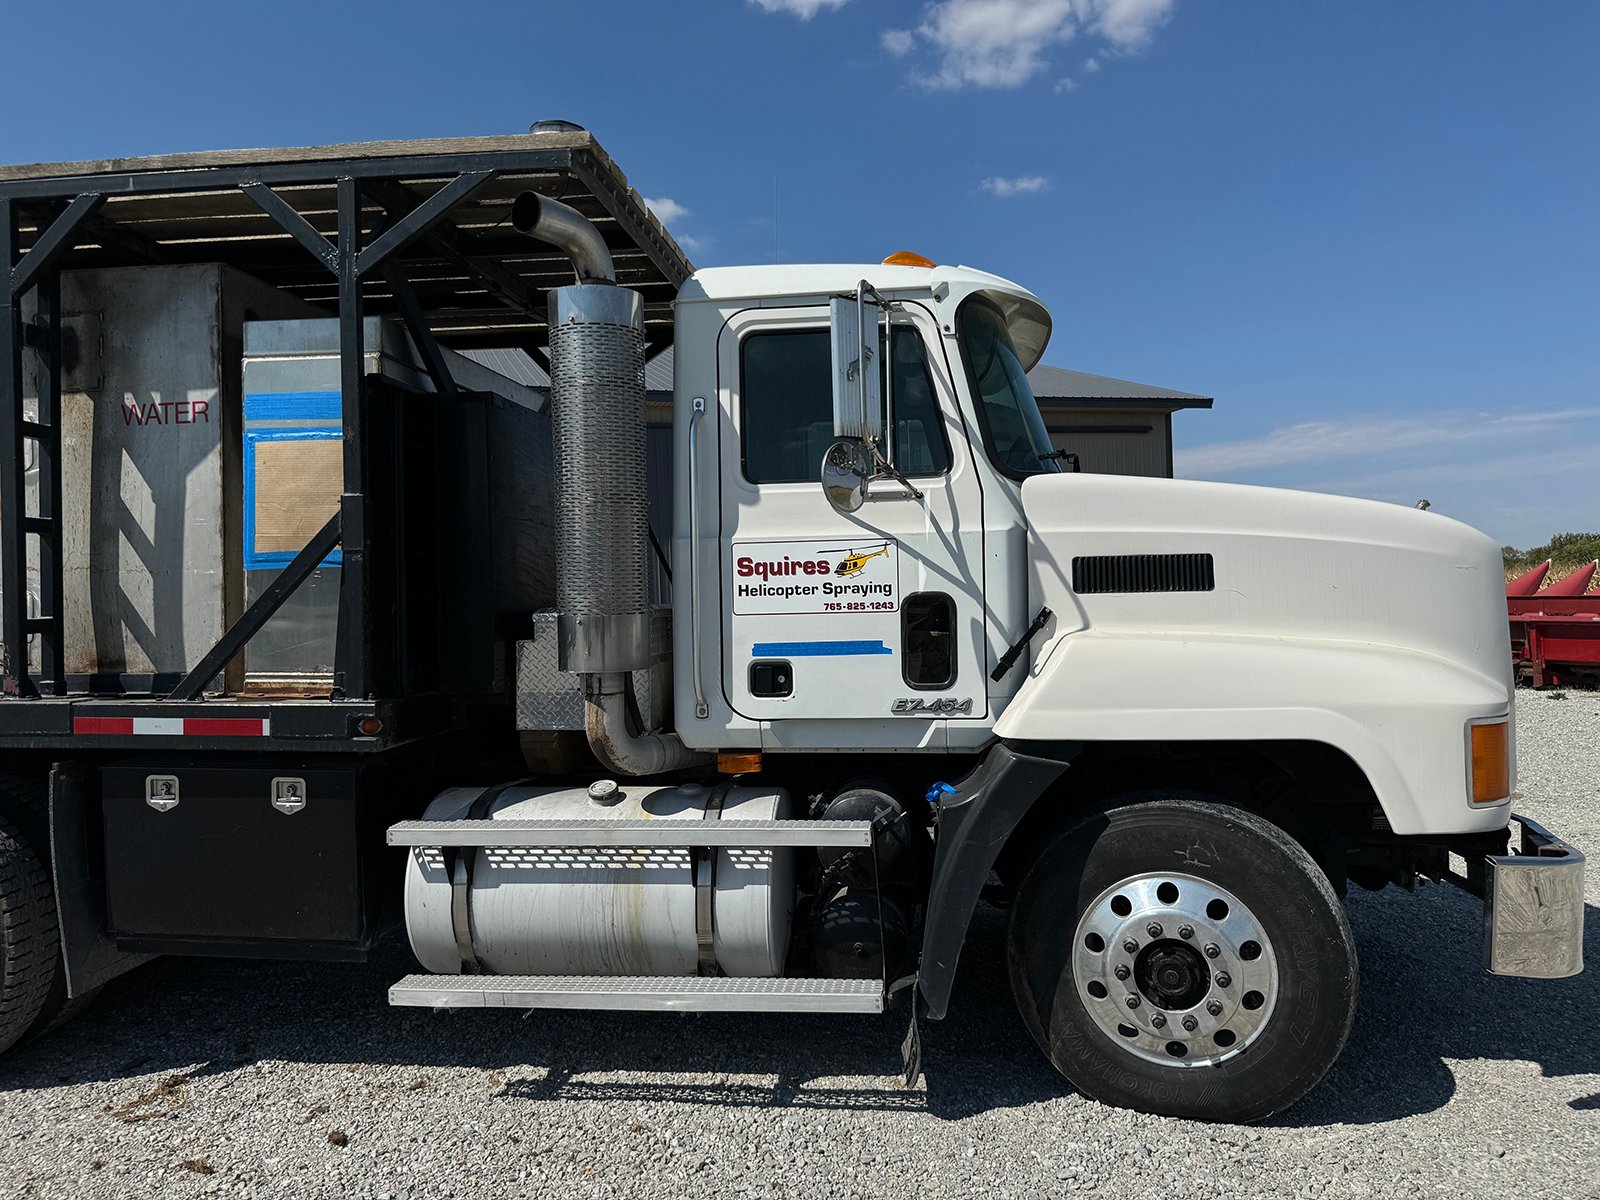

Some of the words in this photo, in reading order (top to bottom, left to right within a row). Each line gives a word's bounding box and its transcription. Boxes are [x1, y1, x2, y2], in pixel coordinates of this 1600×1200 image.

[121, 401, 209, 426] WATER
[737, 556, 830, 581] Squires
[738, 583, 818, 599] Helicopter
[822, 581, 892, 597] Spraying
[1060, 1022, 1184, 1104] YOKOHAMA
